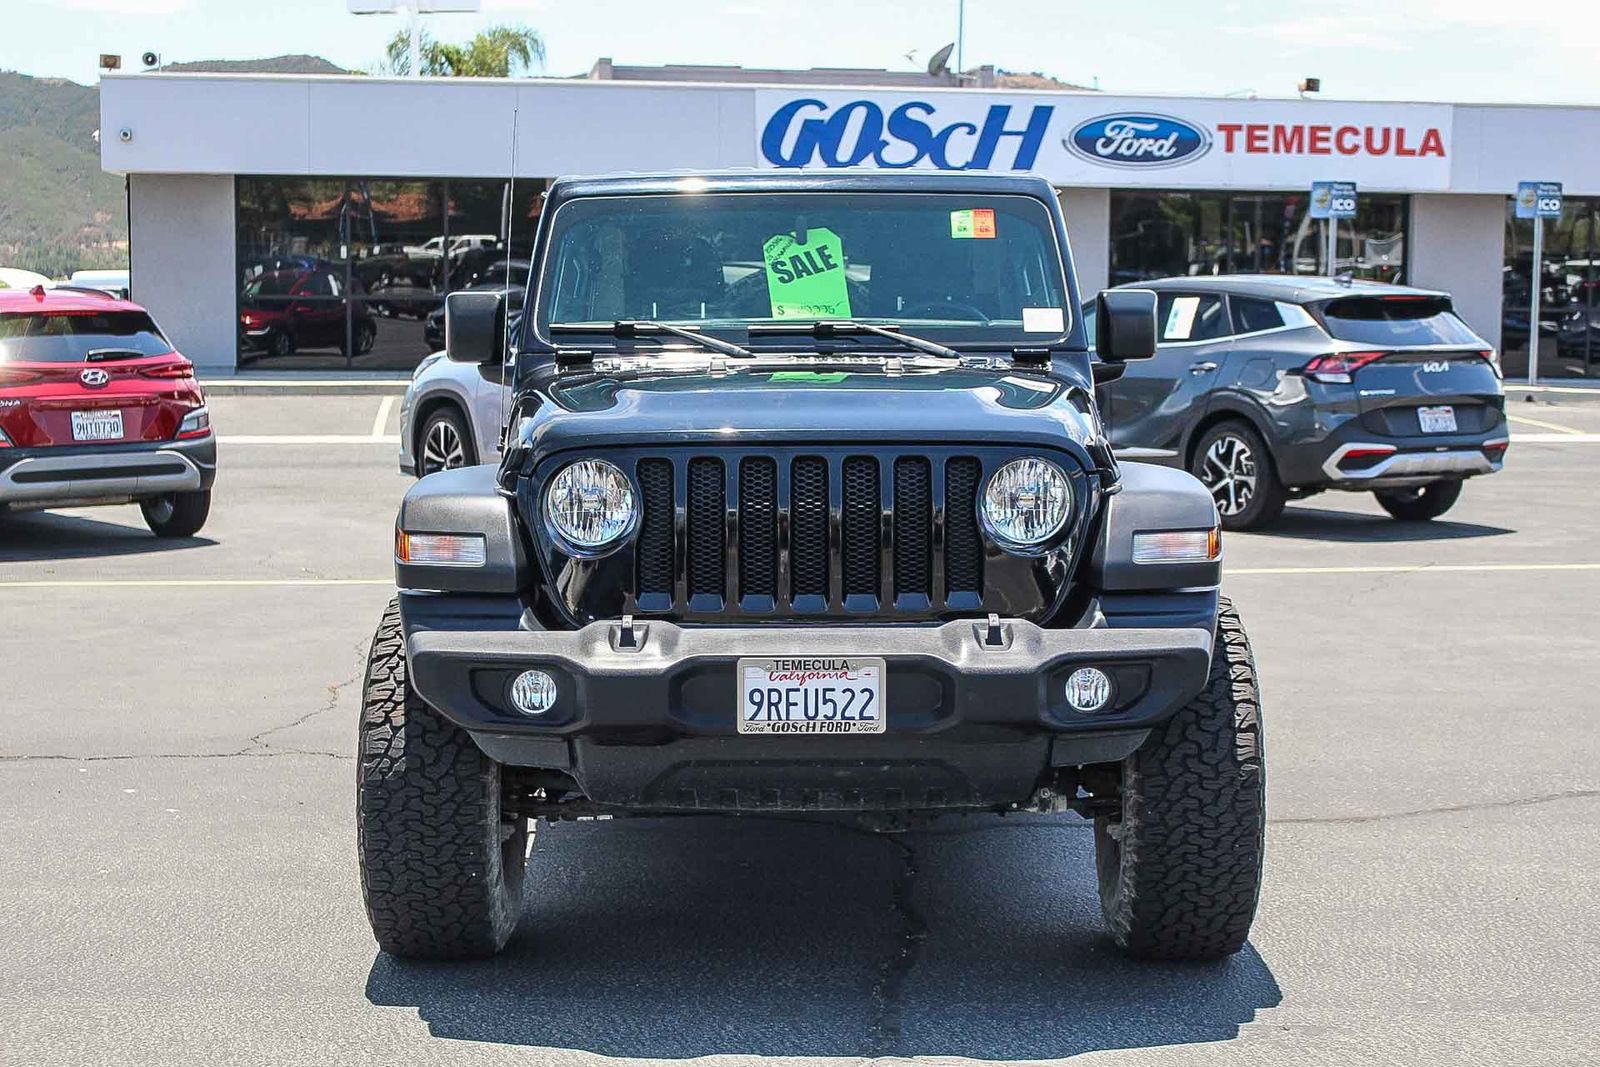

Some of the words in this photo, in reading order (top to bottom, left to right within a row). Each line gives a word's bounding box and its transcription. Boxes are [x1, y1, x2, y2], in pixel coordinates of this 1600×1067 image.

[1095, 120, 1179, 158] Ford
[1217, 124, 1446, 157] TEMECULA
[770, 244, 838, 284] SALE
[768, 671, 858, 686] California
[773, 660, 850, 671] TEMECULA
[748, 688, 875, 721] 9RFU522
[743, 722, 766, 733] Ford
[857, 722, 879, 733] Ford
